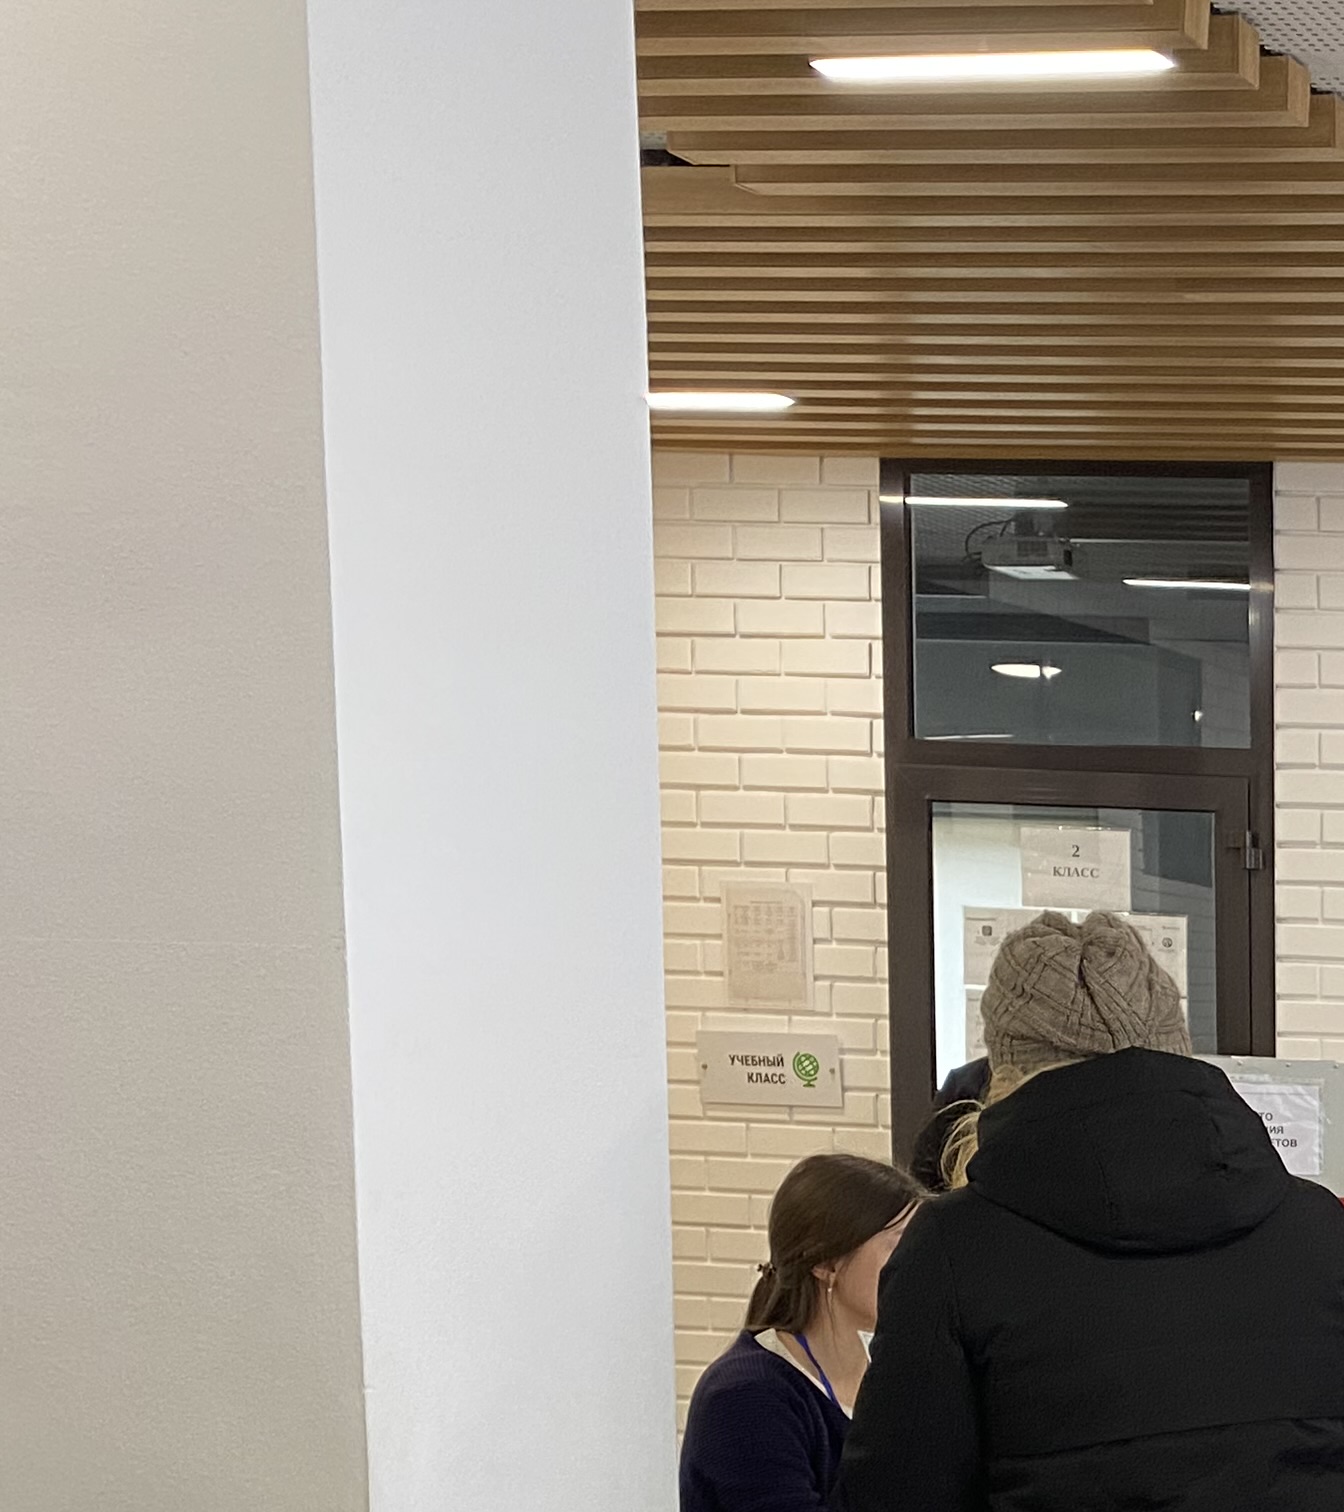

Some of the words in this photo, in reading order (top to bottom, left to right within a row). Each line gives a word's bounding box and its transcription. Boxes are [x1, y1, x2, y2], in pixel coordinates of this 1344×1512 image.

[1072, 845, 1080, 858] 2
[1053, 866, 1100, 879] КЛАСС
[729, 1054, 784, 1067] УЧЕБНЫЙ
[748, 1072, 786, 1084] КЛАСС
